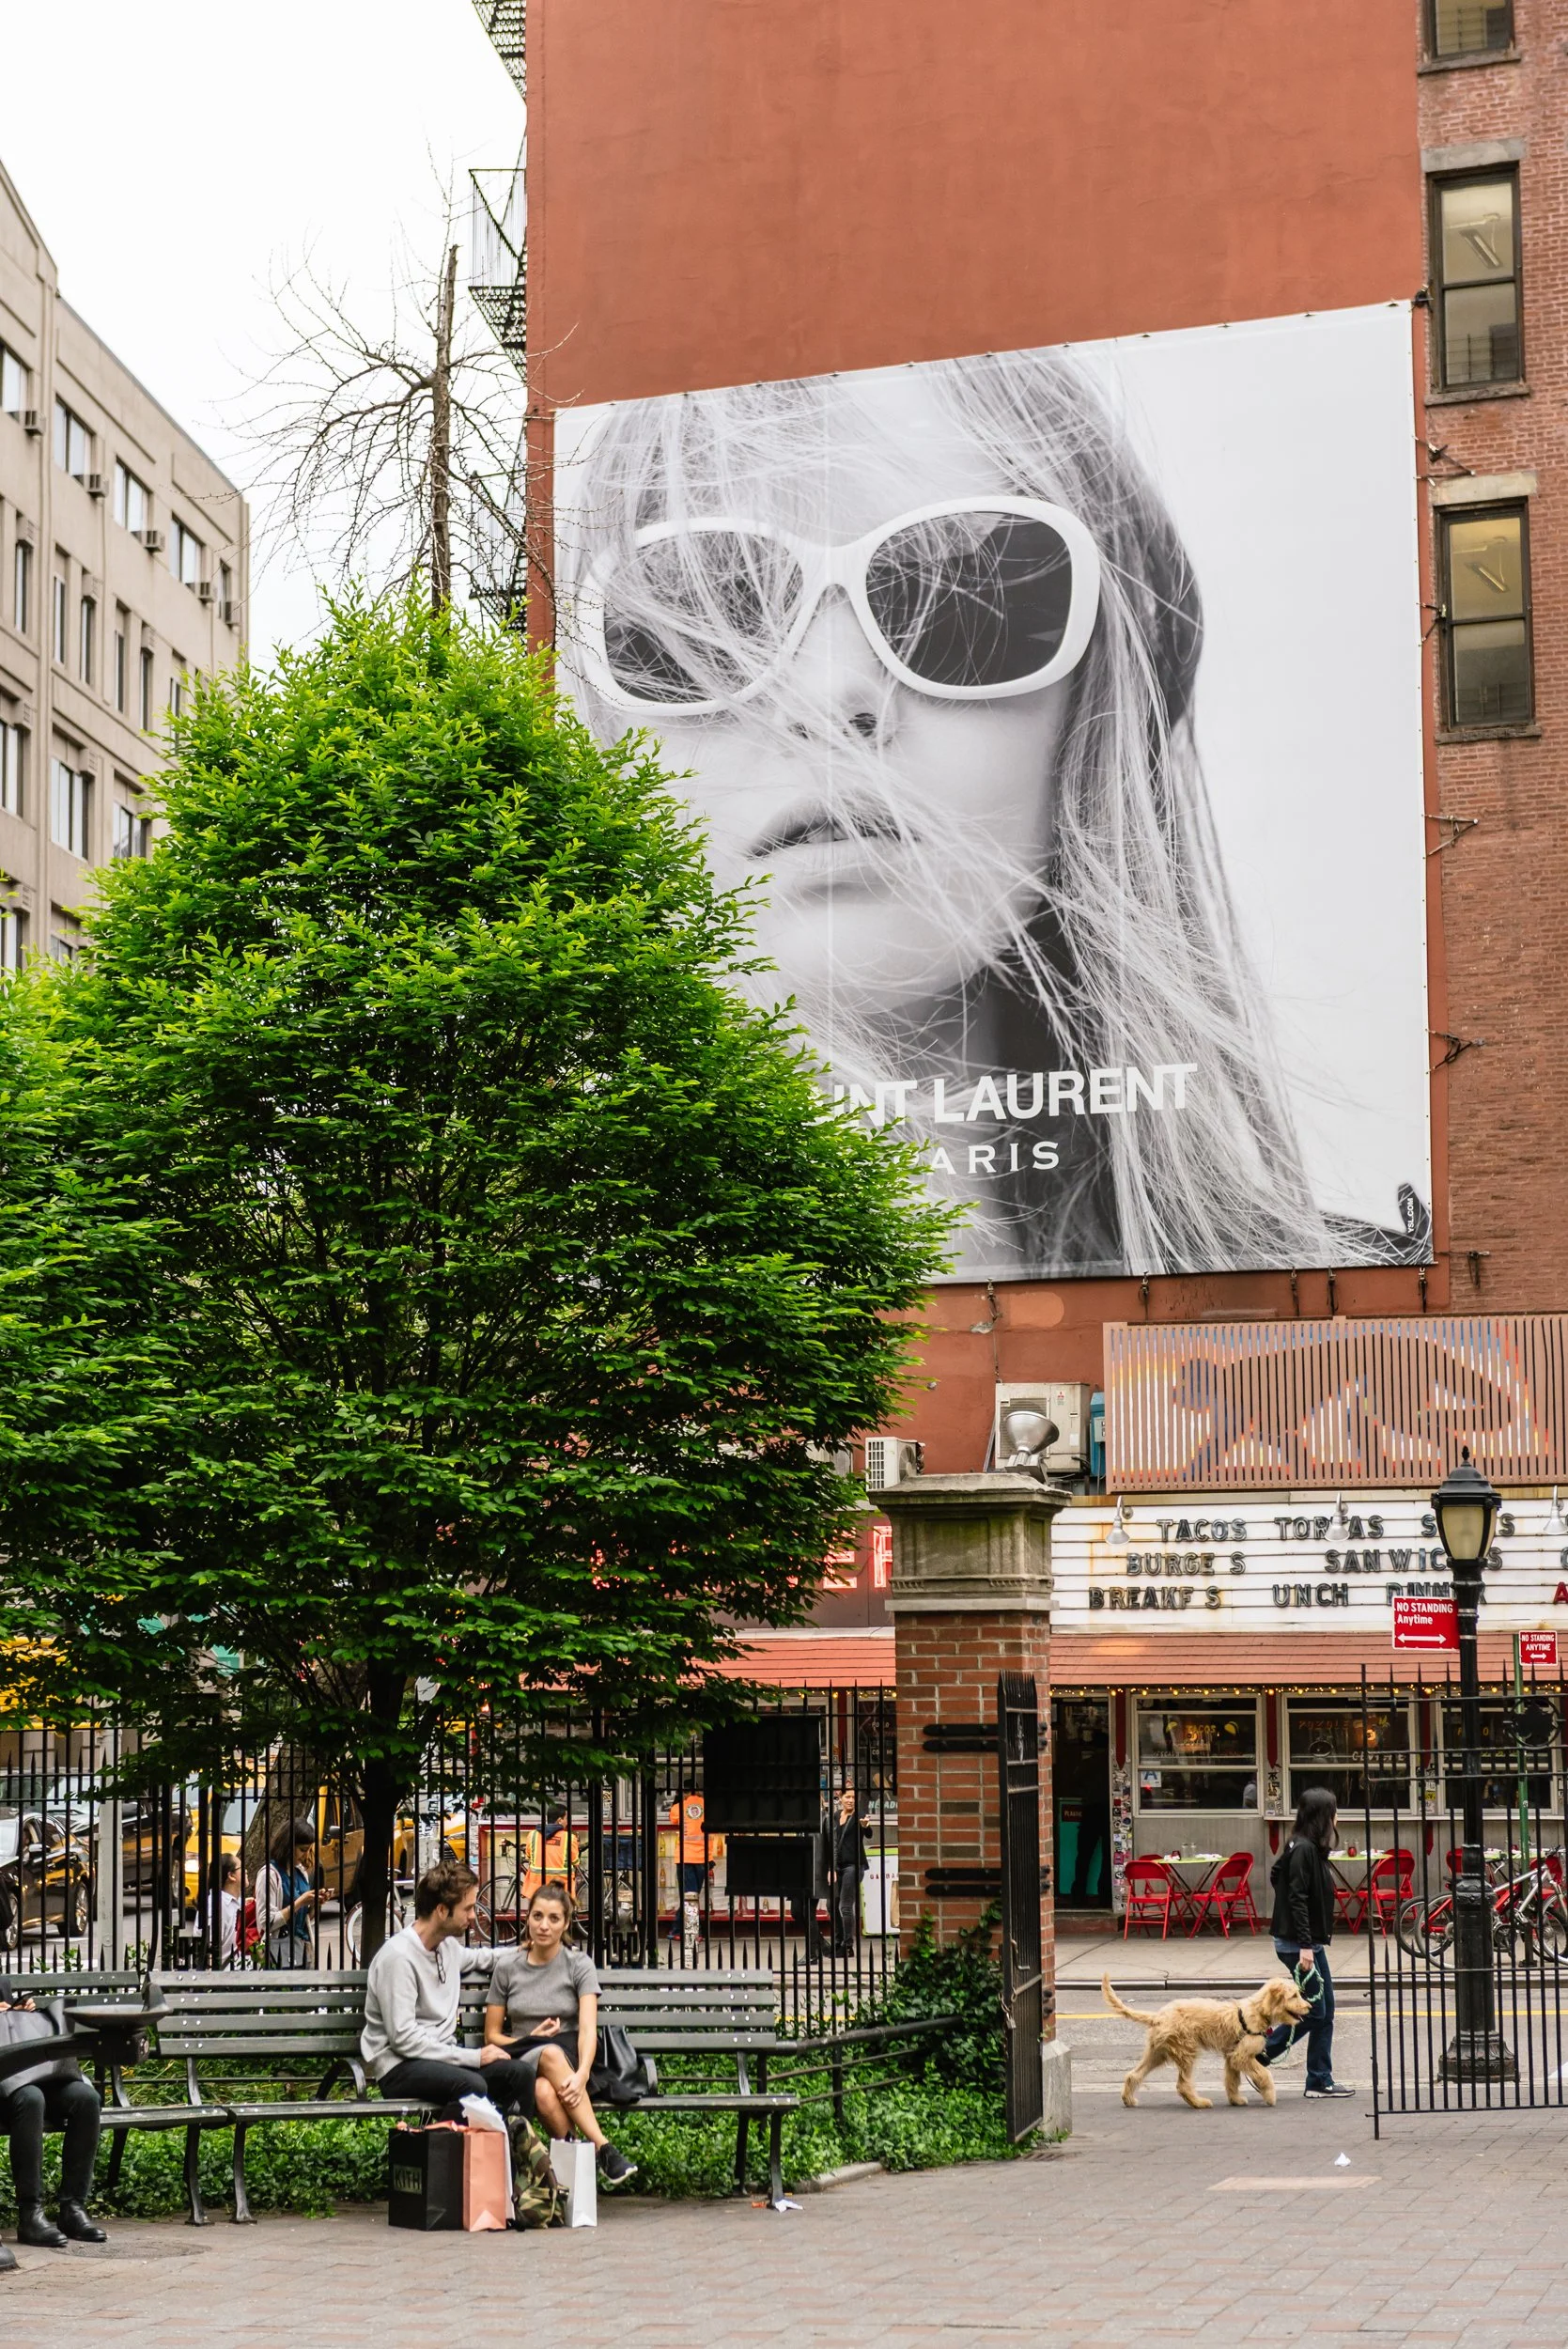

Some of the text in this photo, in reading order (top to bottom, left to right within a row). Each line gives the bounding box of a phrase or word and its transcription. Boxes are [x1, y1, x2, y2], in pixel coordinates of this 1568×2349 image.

[819, 1063, 1198, 1128] INT LAURENT
[1406, 1197, 1415, 1234] YSL.COM
[1157, 1517, 1248, 1543] TACOS
[1272, 1582, 1349, 1608] UNCH
[1396, 1601, 1453, 1614] NO STANDING
[1396, 1613, 1434, 1626] Anytime
[1521, 1634, 1555, 1642] NO STANDING
[1526, 1643, 1551, 1652] ANYTIME
[396, 2170, 421, 2190] KITH
